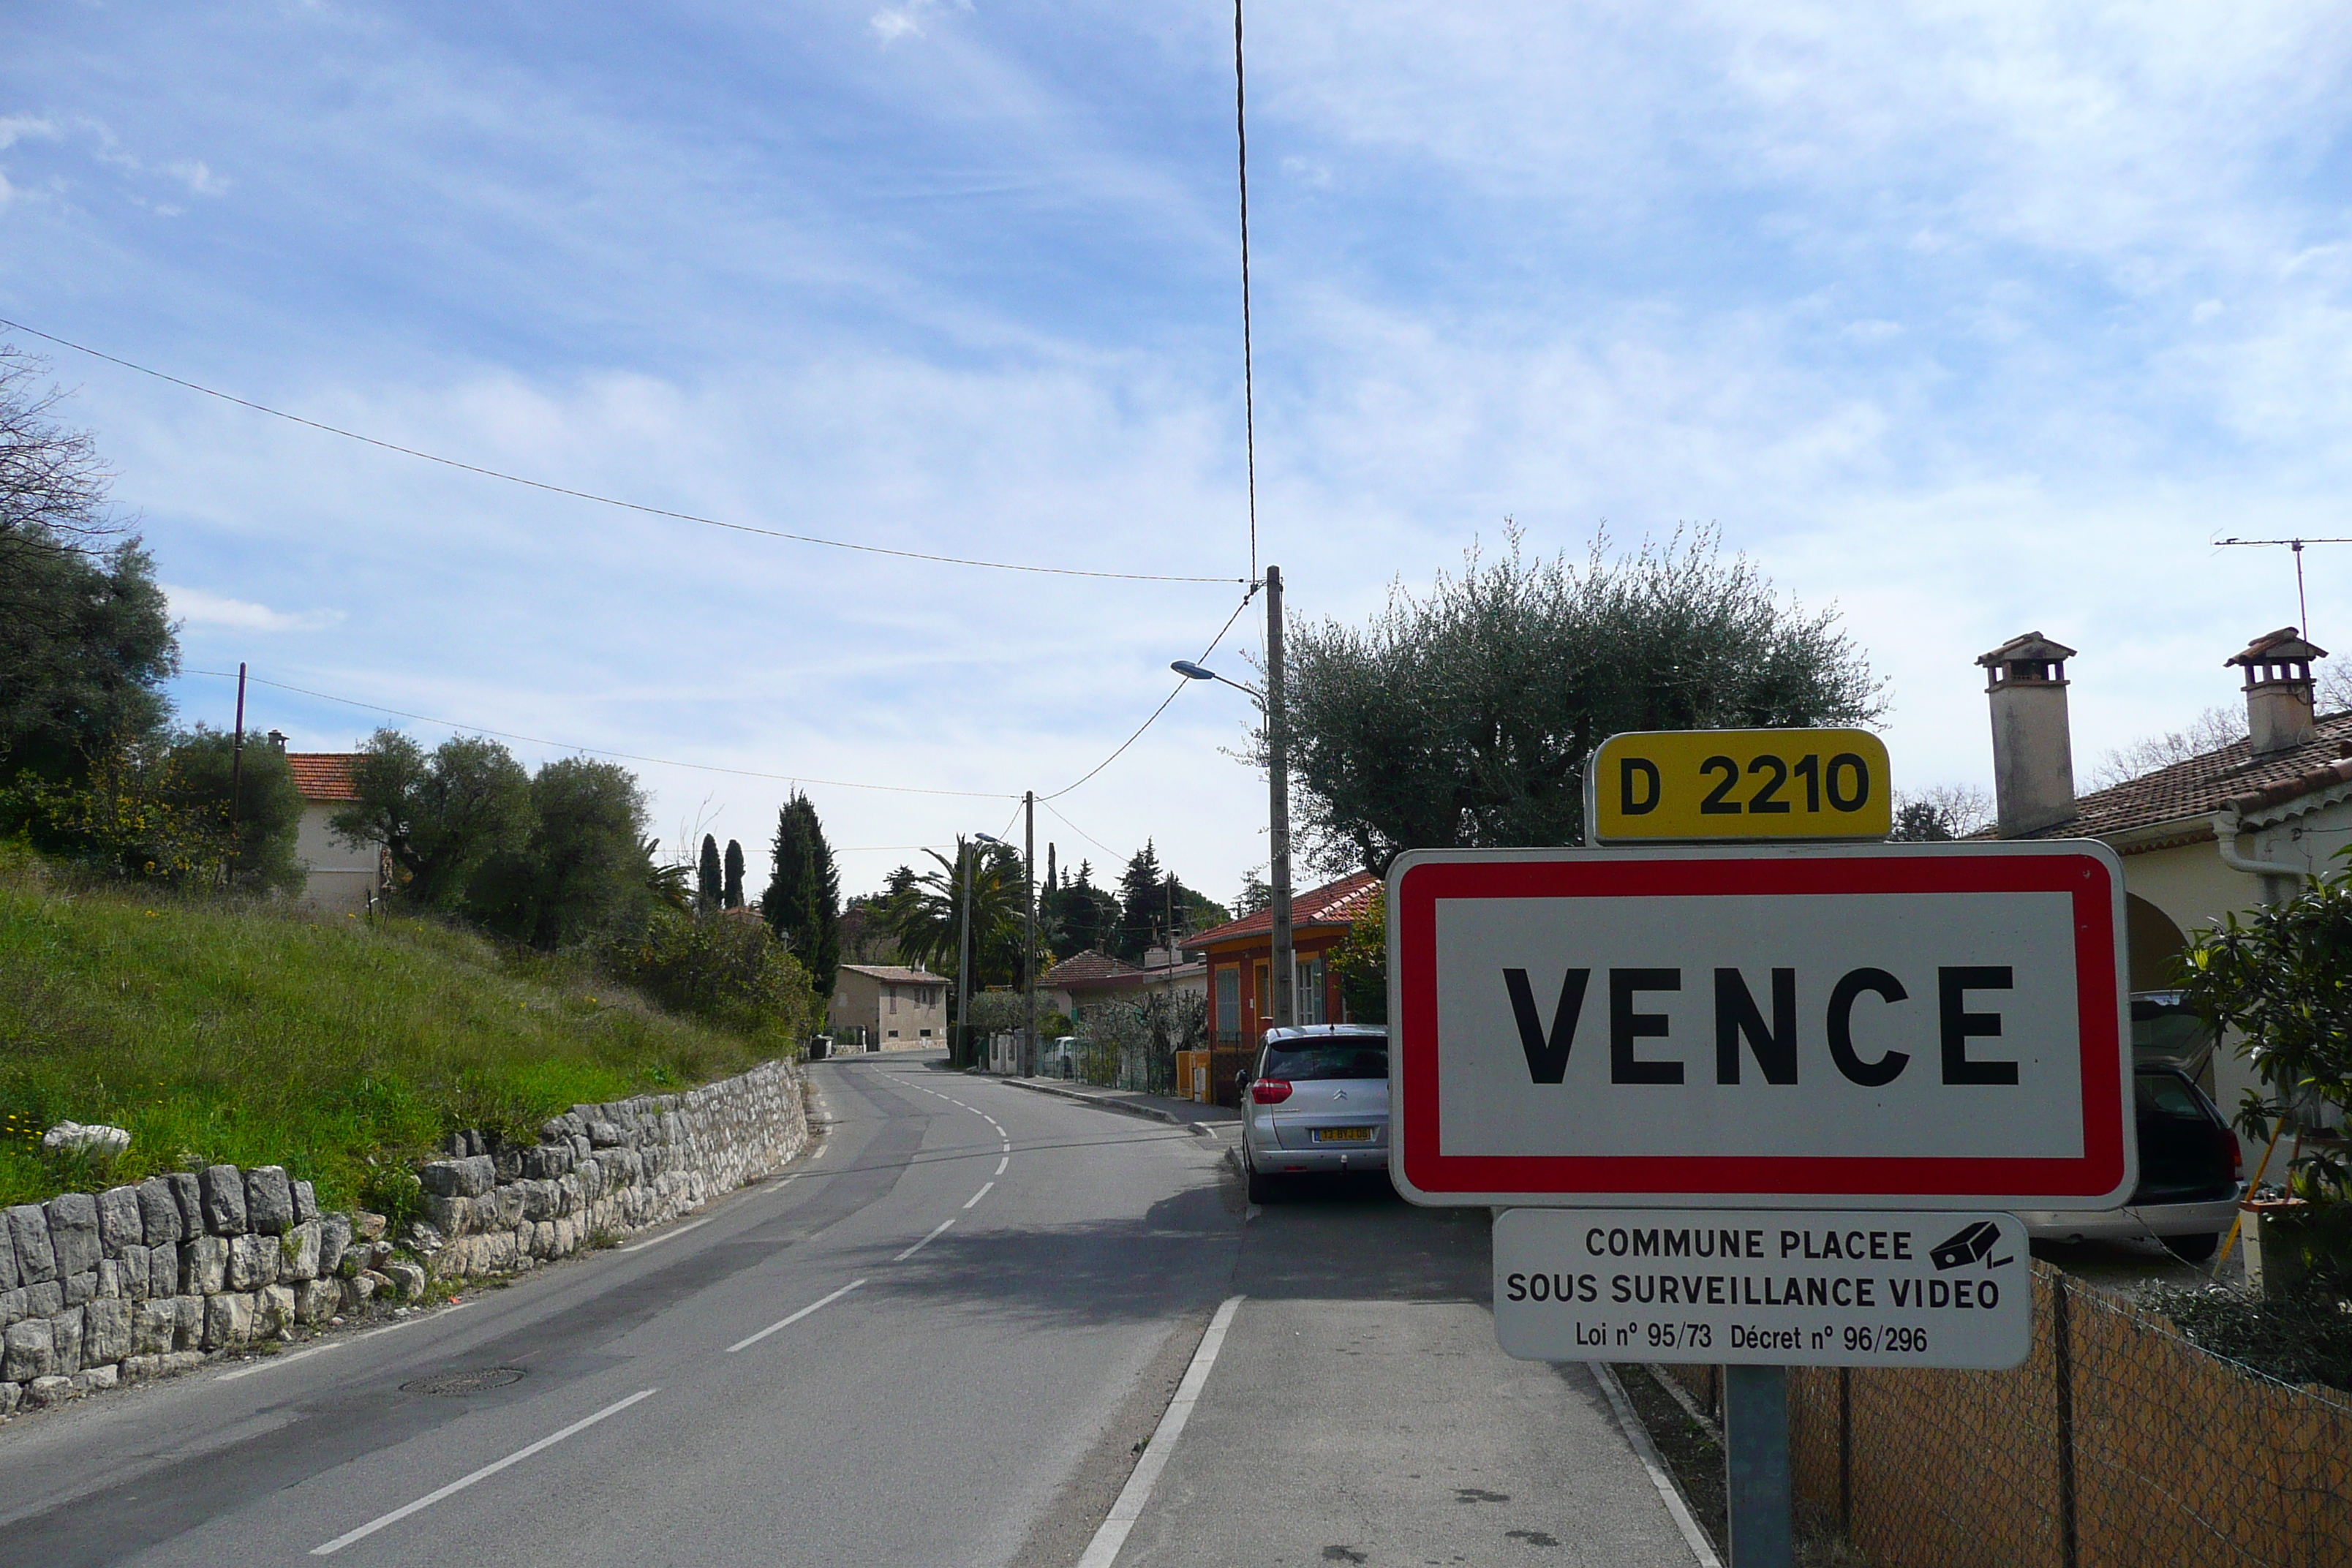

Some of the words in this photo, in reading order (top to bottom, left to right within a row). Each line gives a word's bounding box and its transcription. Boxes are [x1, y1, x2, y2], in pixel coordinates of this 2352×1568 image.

[1621, 758, 1660, 815] D
[1700, 753, 1869, 814] 2210
[1503, 966, 2019, 1087] VENCE
[1586, 1229, 1763, 1258] COMMUNE
[1781, 1231, 1912, 1259] PLACEE
[1507, 1274, 1597, 1302] SOUS
[1612, 1275, 1874, 1306] SURVEILLANCE
[1889, 1279, 1998, 1308] VIDEO
[1577, 1322, 1606, 1346] Loi
[1648, 1322, 1711, 1349] 95/73
[1731, 1325, 1801, 1349] Décret
[1844, 1325, 1927, 1353] 96/296
